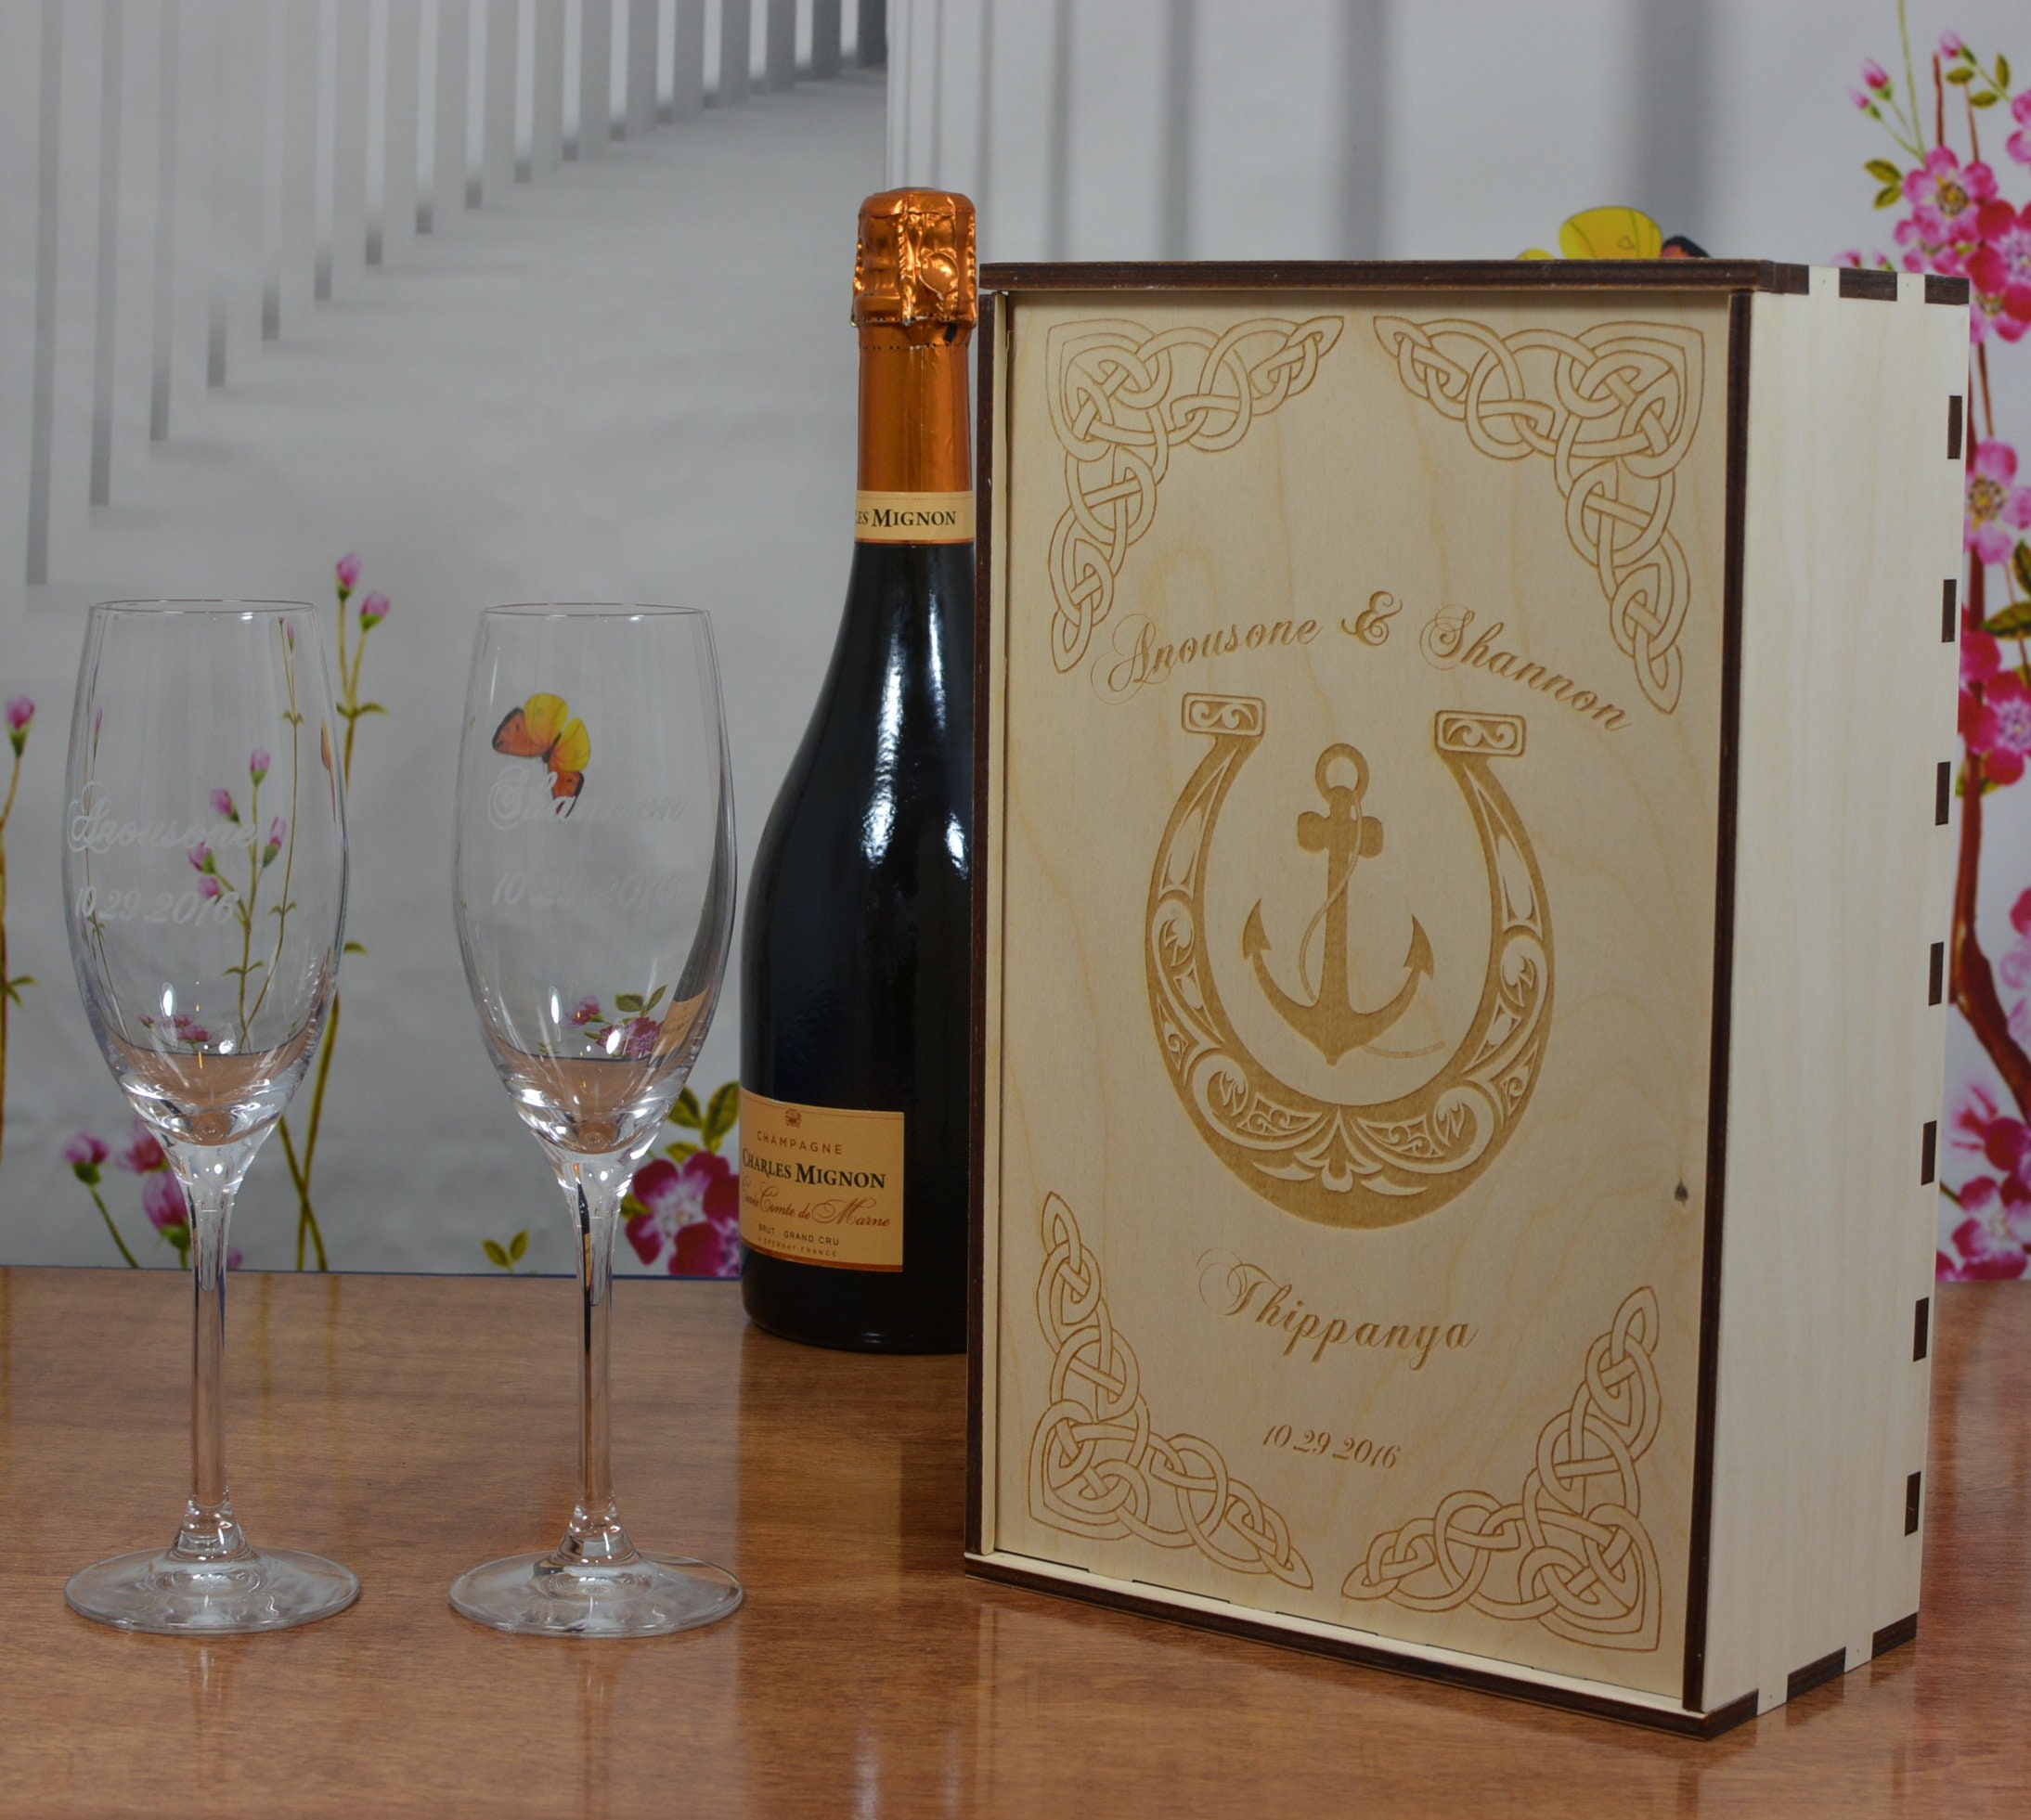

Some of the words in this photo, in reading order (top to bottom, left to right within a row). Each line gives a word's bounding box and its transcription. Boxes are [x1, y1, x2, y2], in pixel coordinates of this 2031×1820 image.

[872, 508, 957, 527] MIGNON
[1091, 613, 1323, 704] Anousone
[1341, 591, 1403, 645] &
[1420, 604, 1633, 731] Shannon
[757, 1130, 844, 1155] CHAMPAGNE
[743, 1148, 792, 1179] CHARLES
[796, 1163, 886, 1189] MIGNON
[759, 1181, 796, 1217] Comte
[797, 1203, 810, 1220] de
[812, 1196, 891, 1227] Marne
[757, 1223, 775, 1234] BRUT
[783, 1231, 814, 1243] GRAND
[818, 1236, 839, 1246] CRU
[1196, 1248, 1480, 1371] Thippanya
